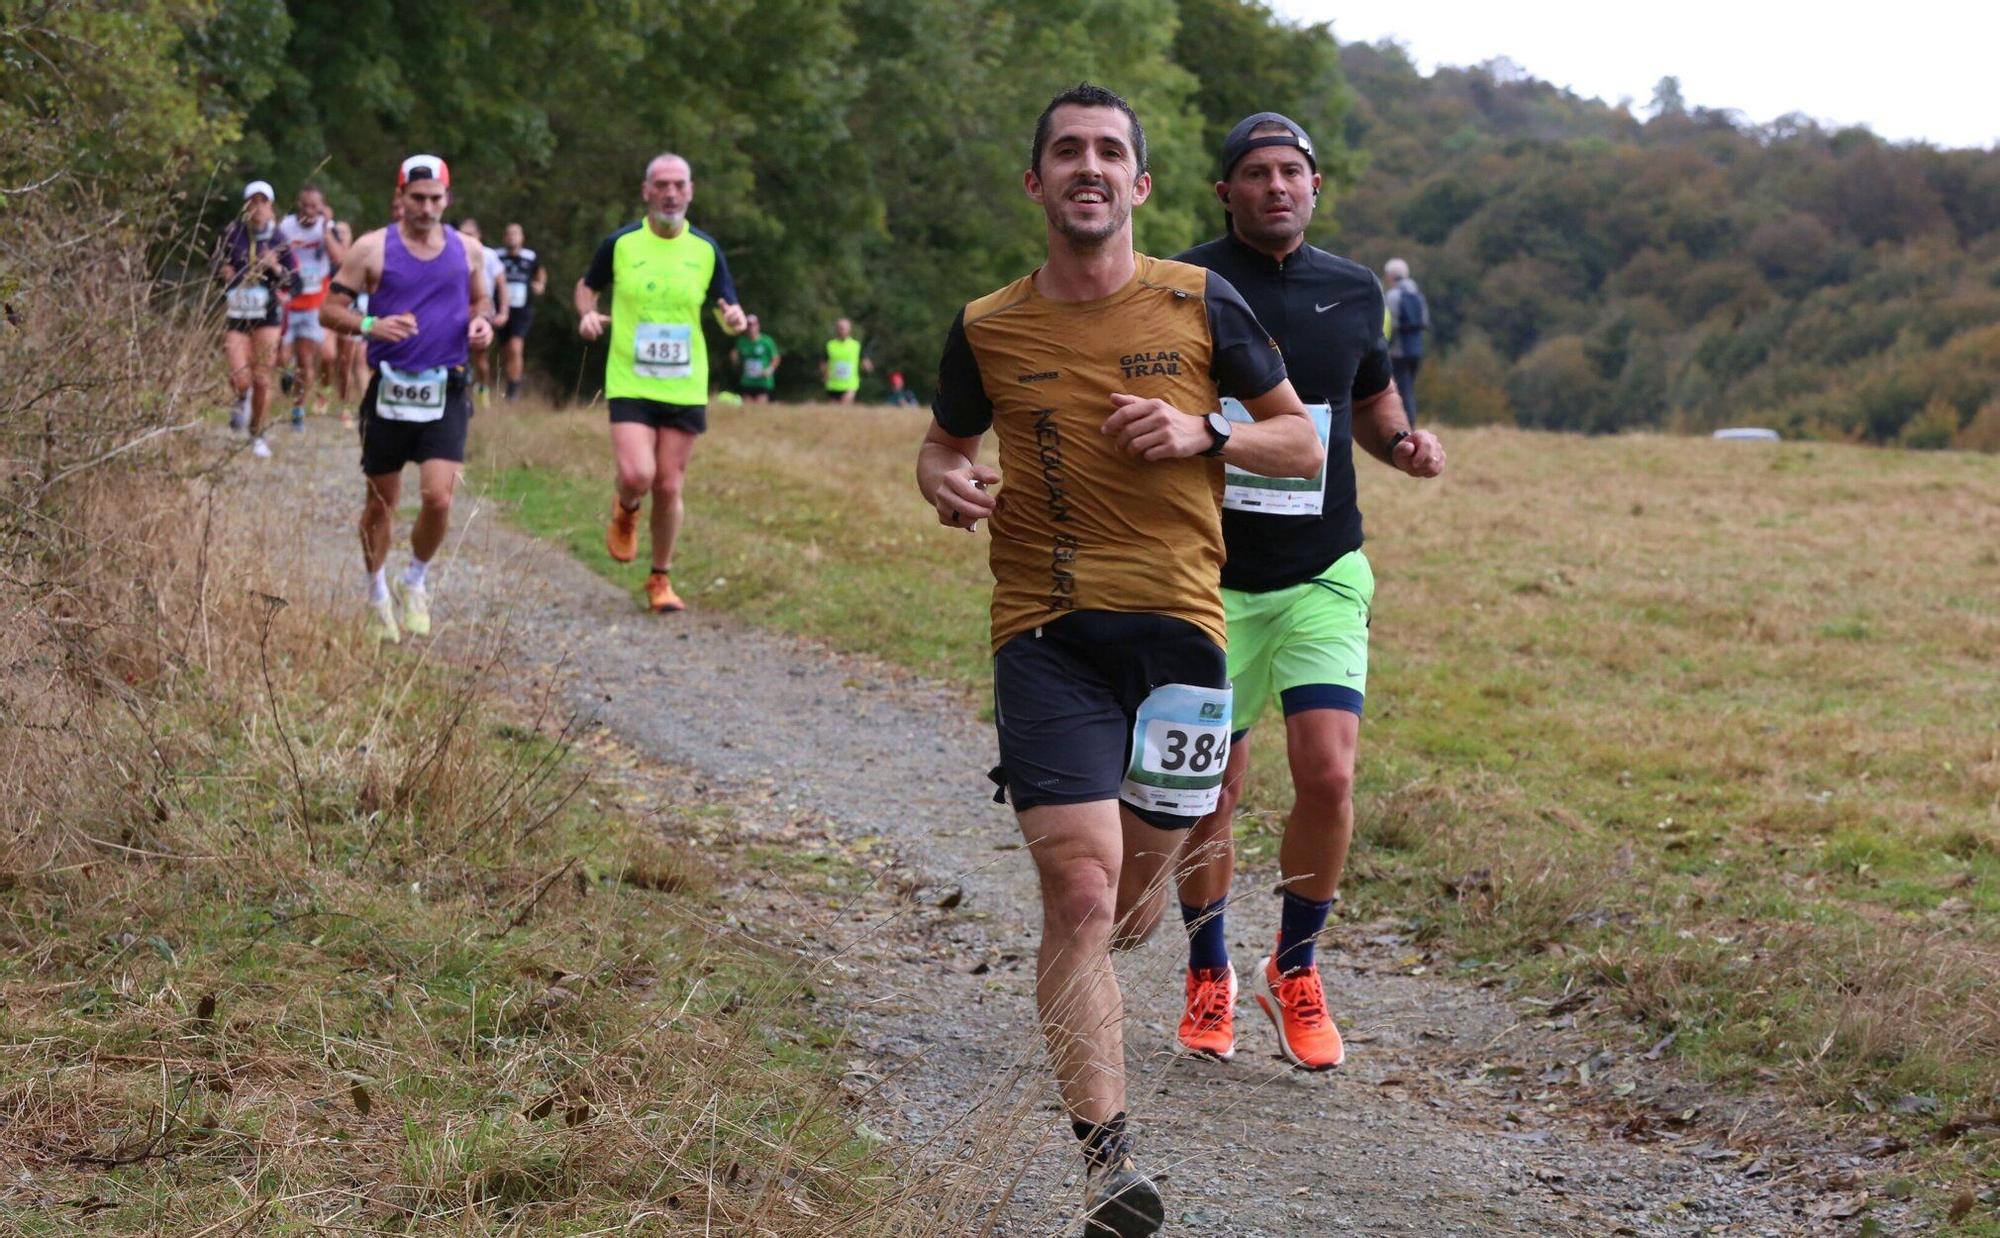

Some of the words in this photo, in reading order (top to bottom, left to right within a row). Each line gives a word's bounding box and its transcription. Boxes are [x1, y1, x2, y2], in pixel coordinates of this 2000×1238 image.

[646, 342, 681, 360] 483
[1120, 351, 1181, 366] GALAR
[1120, 363, 1182, 379] TRAIL
[392, 384, 431, 401] 666
[1160, 729, 1229, 773] 384
